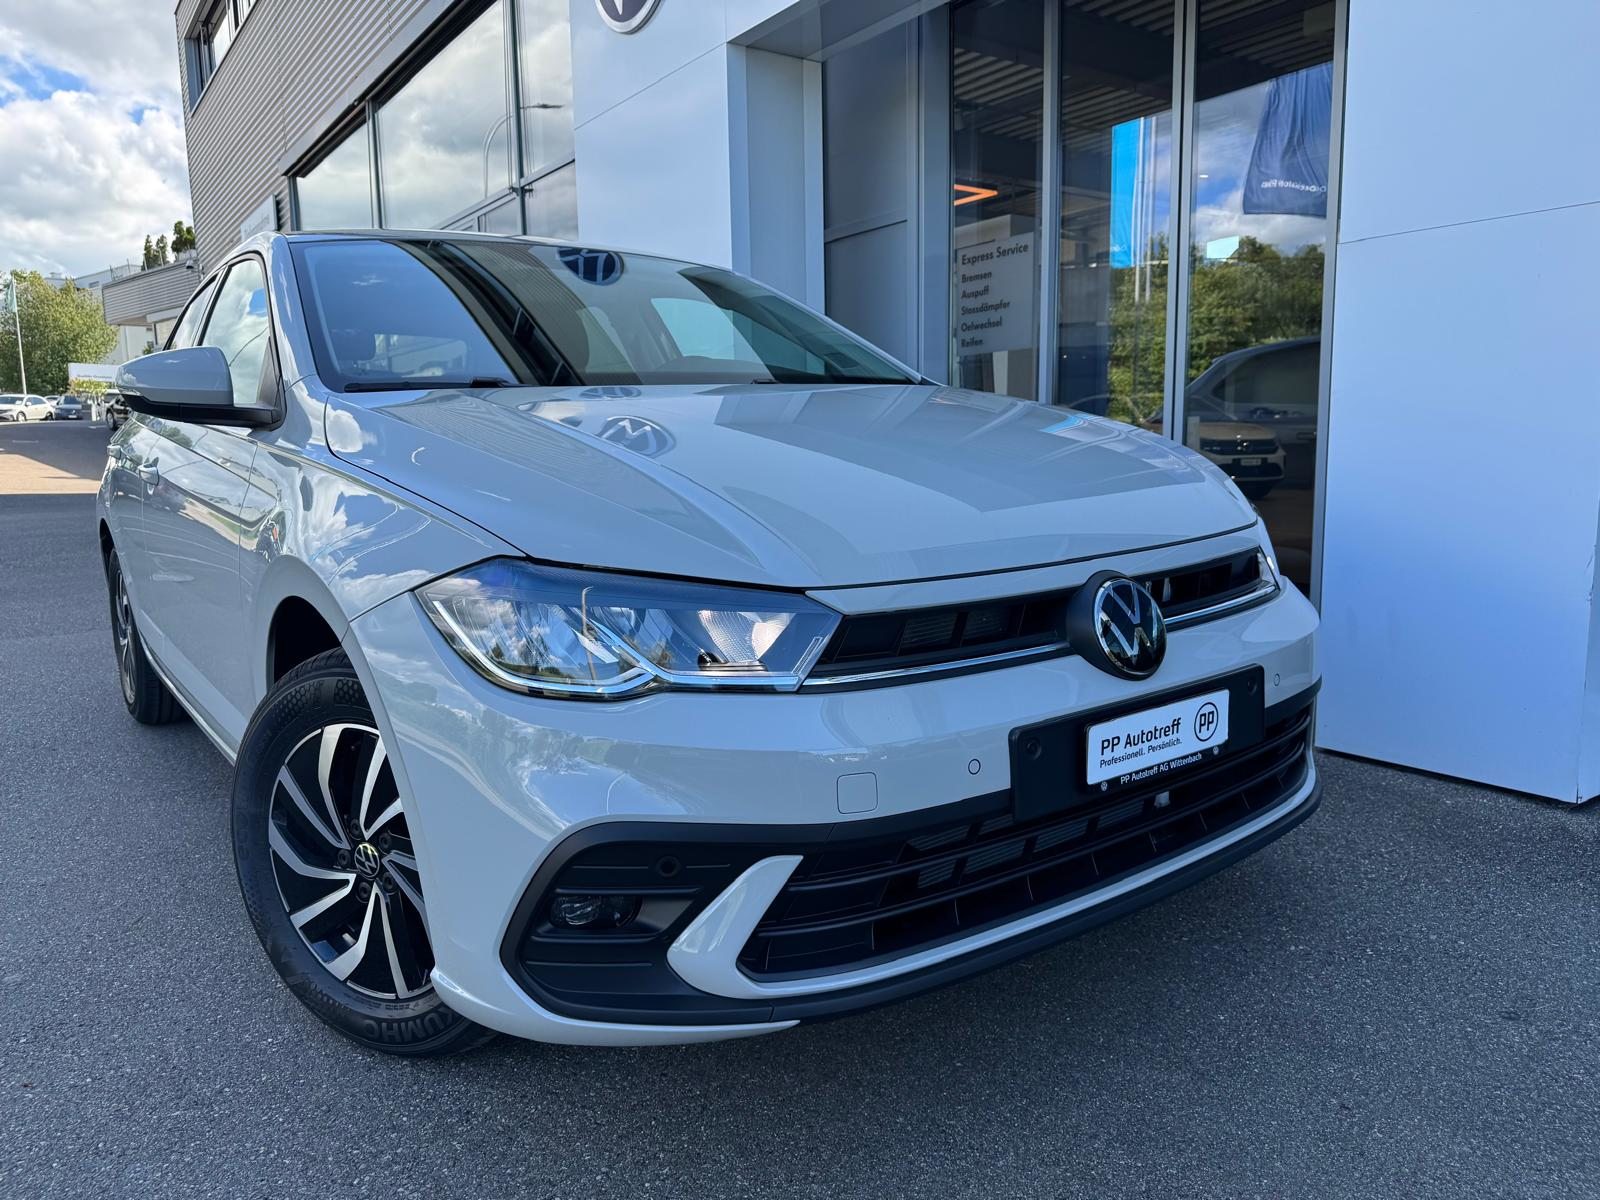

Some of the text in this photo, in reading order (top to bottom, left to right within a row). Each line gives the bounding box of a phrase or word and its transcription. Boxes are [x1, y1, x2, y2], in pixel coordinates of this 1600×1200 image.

[961, 243, 1029, 266] Express Service
[961, 271, 992, 283] Bremsen
[960, 285, 990, 299] Auspuff
[1199, 710, 1215, 733] PP
[1101, 717, 1182, 756] PP Autotreff
[1100, 738, 1182, 768] Professionell. Persönlich.
[1120, 752, 1203, 785] PP Autotreff AG Wittenbach
